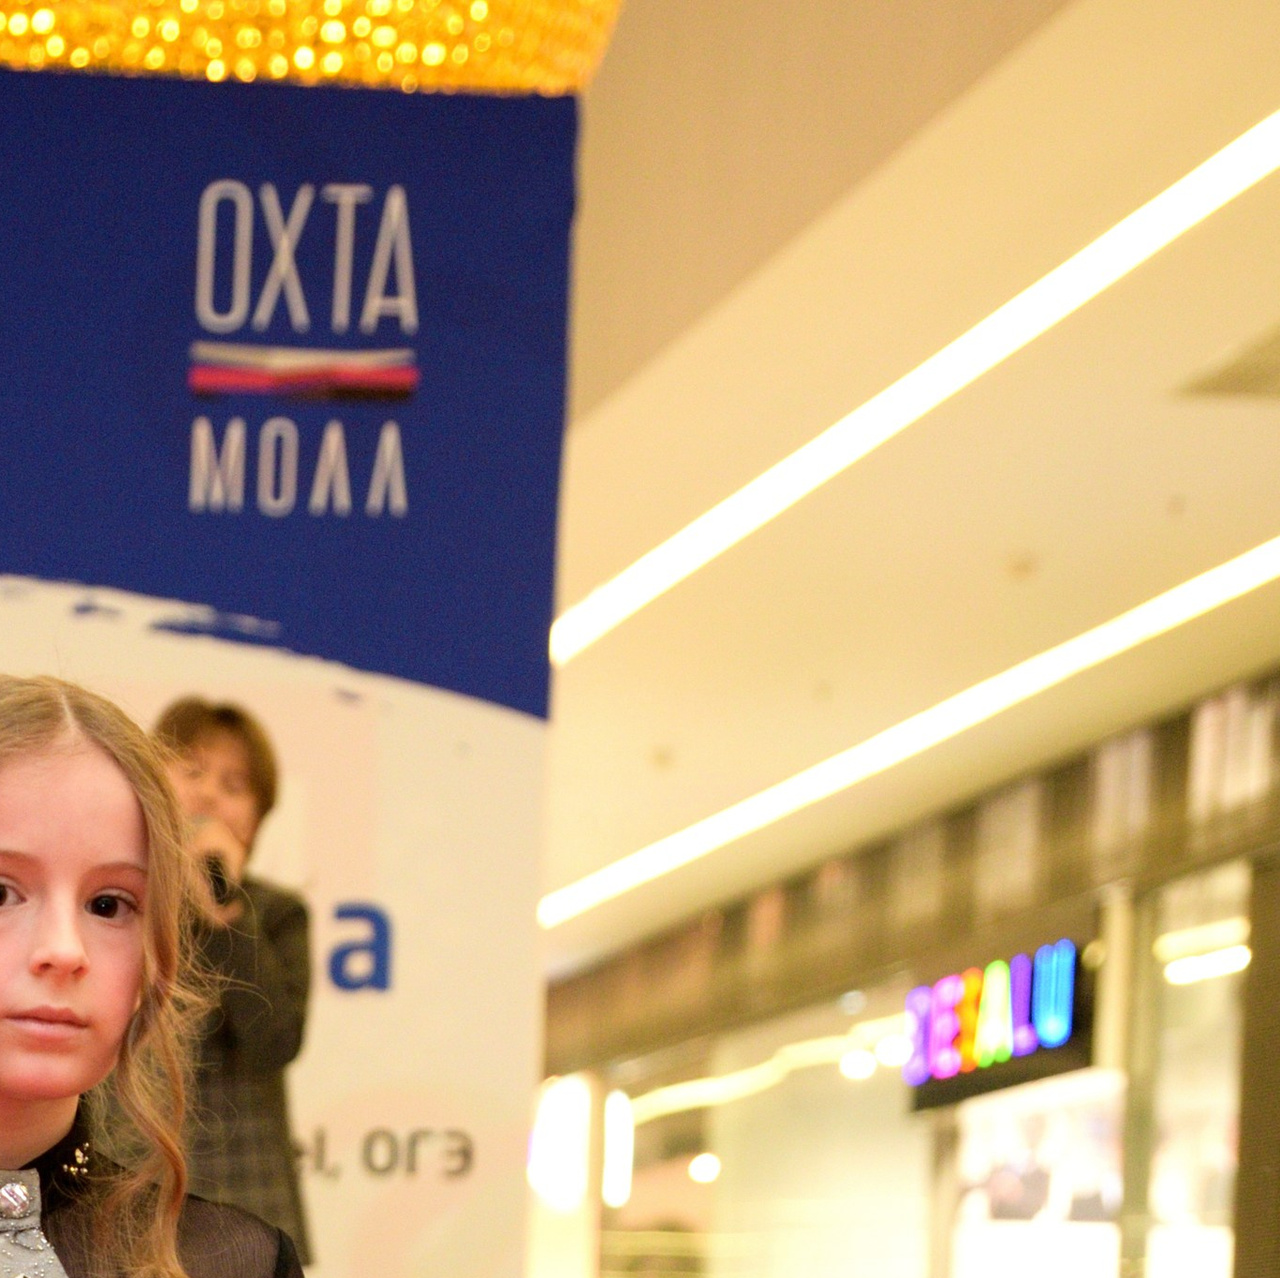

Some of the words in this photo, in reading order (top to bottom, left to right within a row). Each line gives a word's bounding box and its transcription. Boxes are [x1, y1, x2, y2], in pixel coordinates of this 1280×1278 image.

[195, 179, 418, 334] ОХТА
[188, 416, 407, 518] МОЛЛ
[361, 1126, 474, 1178] ОГЭ
